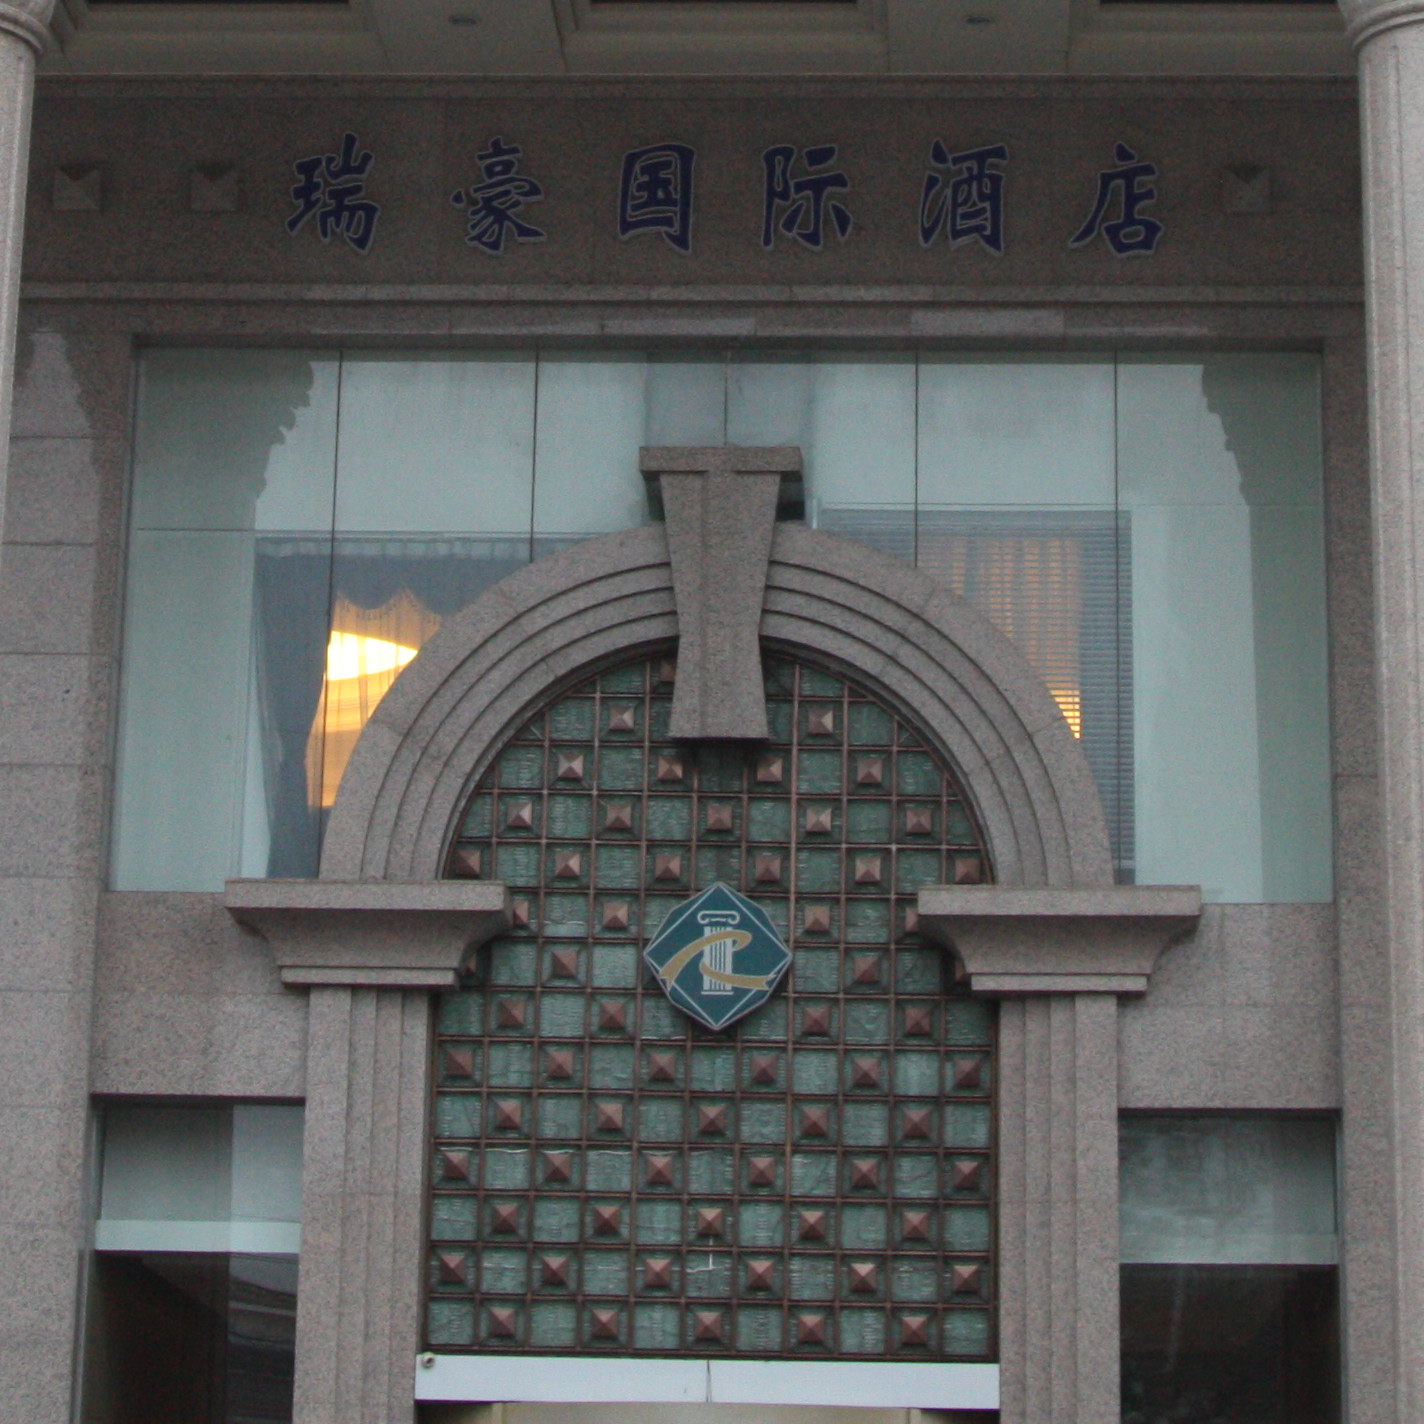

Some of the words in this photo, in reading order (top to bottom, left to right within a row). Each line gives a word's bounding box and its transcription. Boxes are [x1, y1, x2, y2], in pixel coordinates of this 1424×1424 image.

[284, 131, 1166, 258] 瑞豪国际酒店
